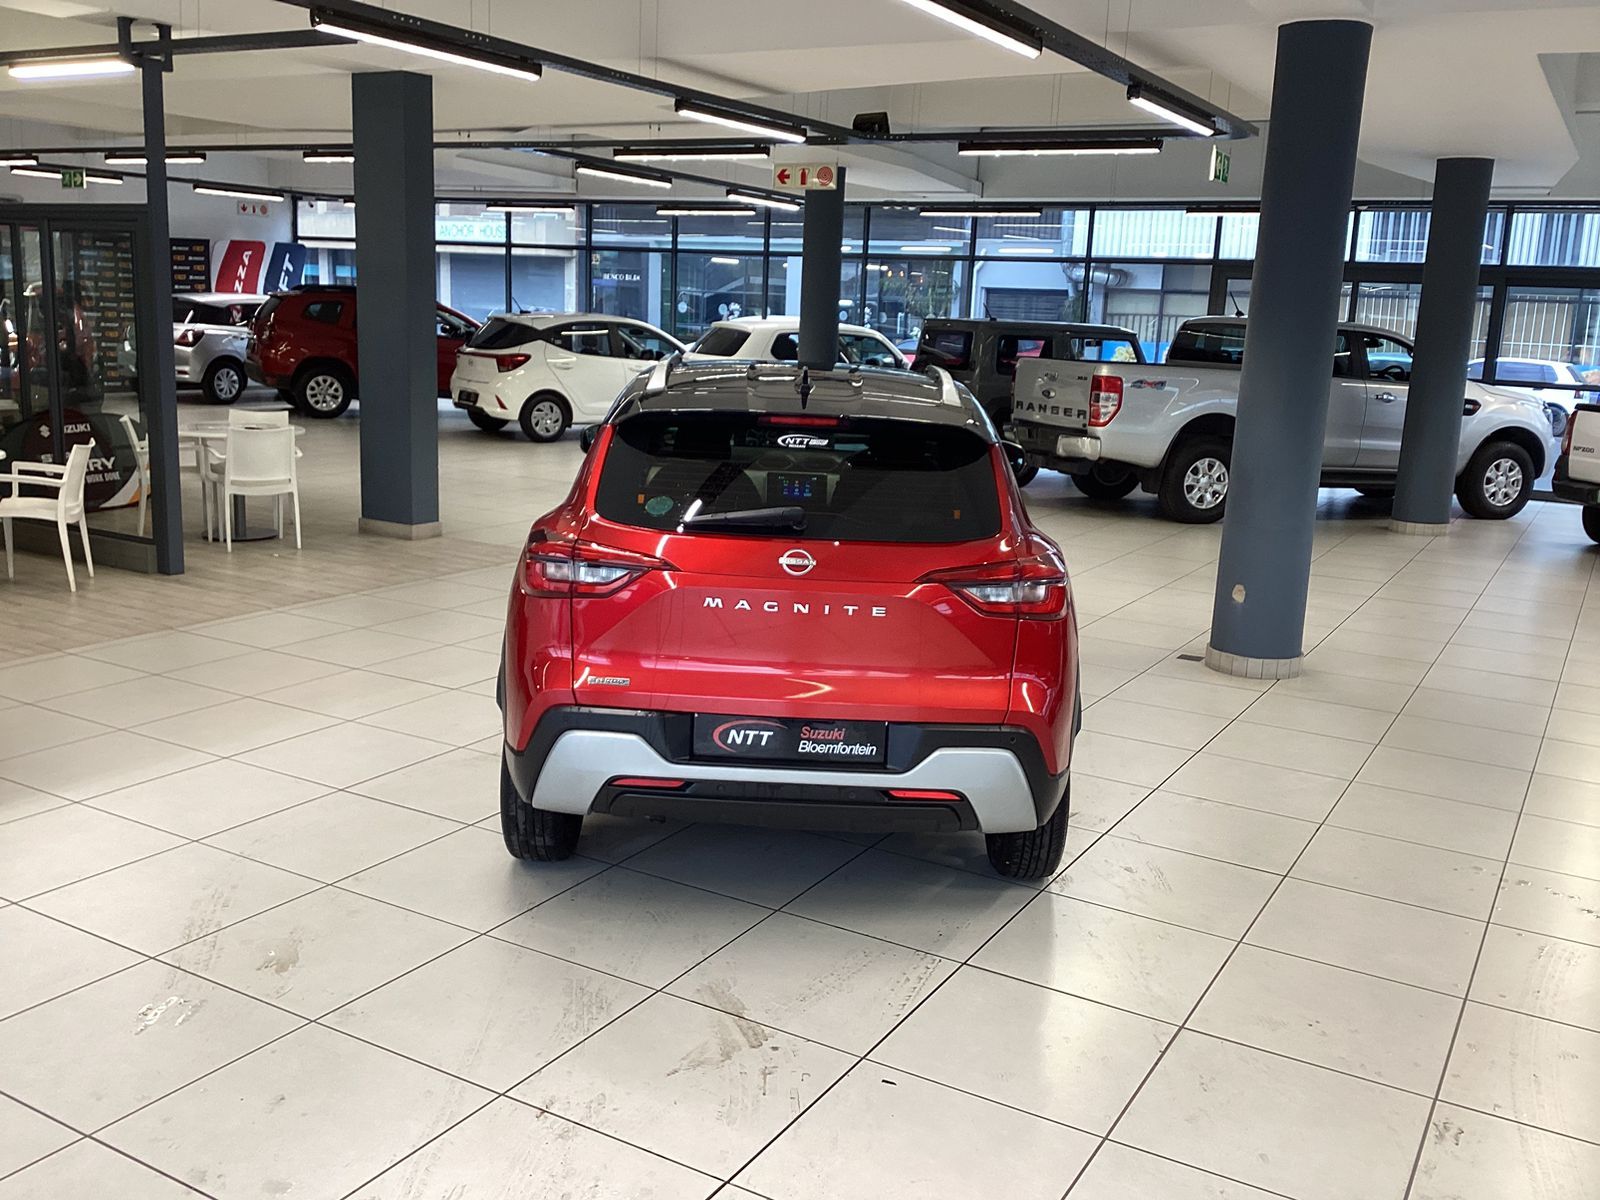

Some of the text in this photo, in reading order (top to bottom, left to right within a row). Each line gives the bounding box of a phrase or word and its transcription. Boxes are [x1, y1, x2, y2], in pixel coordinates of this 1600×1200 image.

[439, 223, 504, 238] ANCHOR HOUS
[278, 252, 294, 292] FT
[1015, 400, 1087, 420] RANGER
[785, 437, 810, 445] NTT
[778, 556, 817, 566] NISSAN
[703, 597, 887, 617] MAGNITE
[726, 729, 774, 746] NTT
[800, 726, 846, 740] Suzuki
[798, 740, 877, 756] Bloemfontein
